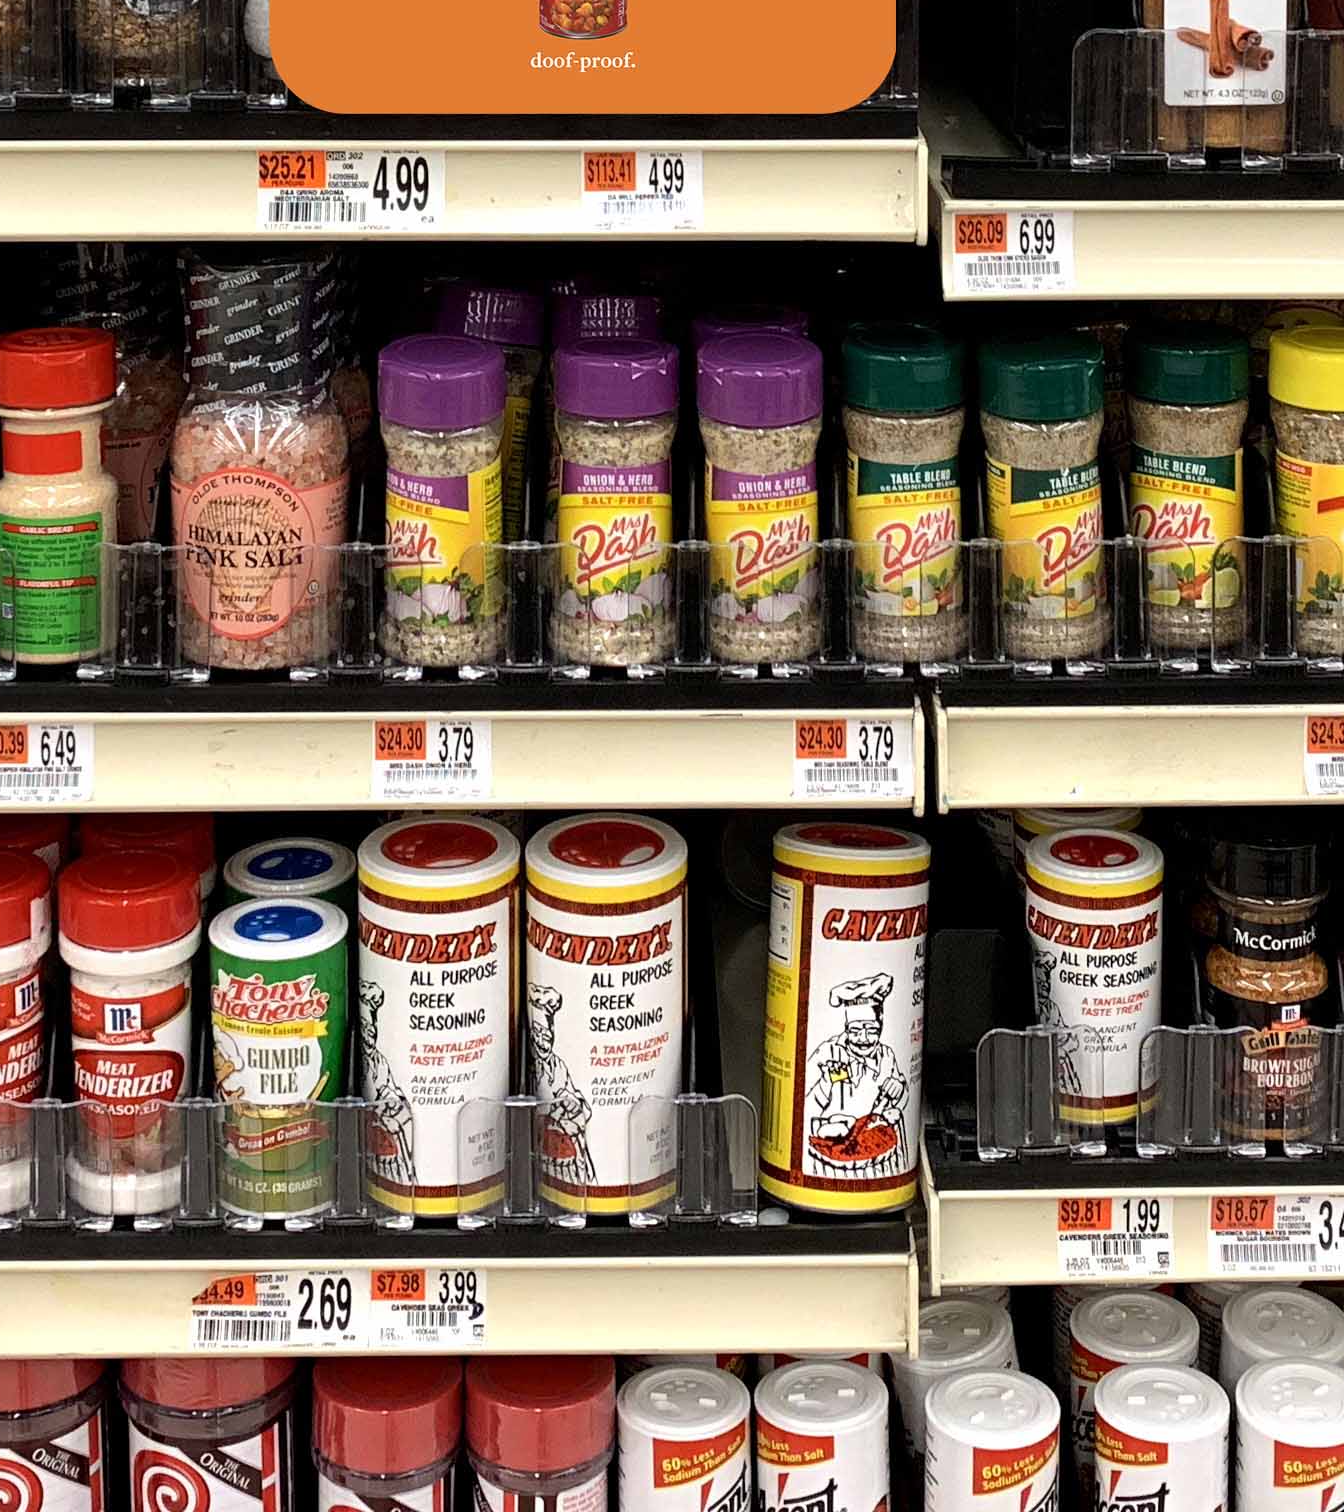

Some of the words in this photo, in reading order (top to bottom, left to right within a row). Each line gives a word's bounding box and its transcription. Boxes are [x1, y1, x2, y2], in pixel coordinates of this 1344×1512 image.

[259, 156, 315, 179] $25.21
[373, 156, 429, 211] 4.99
[959, 223, 1004, 247] $26.09
[1020, 218, 1056, 255] 6.99
[1143, 456, 1170, 471] TABLE
[1172, 461, 1206, 475] BLEND
[584, 475, 615, 485] ONION
[618, 475, 625, 485] &
[628, 475, 653, 485] HERB
[192, 478, 219, 504] OLDE
[224, 475, 299, 512] THOMPSON
[189, 525, 303, 546] HIMALAYAN
[573, 514, 656, 569] Dash
[1234, 927, 1317, 952] McCormick
[410, 970, 434, 987] ALL
[442, 962, 497, 986] PURPOSE
[230, 975, 314, 1002] Tony
[409, 993, 455, 1011] GREEK
[409, 1011, 486, 1030] SEASONING
[422, 1032, 494, 1052] TANTALIZING
[248, 1045, 310, 1070] GUMBO
[1061, 1200, 1101, 1222] $9.81
[1123, 1199, 1160, 1232] 1.99
[377, 1272, 419, 1293] $7.98
[440, 1272, 476, 1304] 3.99
[298, 1278, 352, 1330] 2.69
[662, 1458, 691, 1471] 60%
[693, 1448, 714, 1464] Less
[663, 1466, 701, 1483] Sodium
